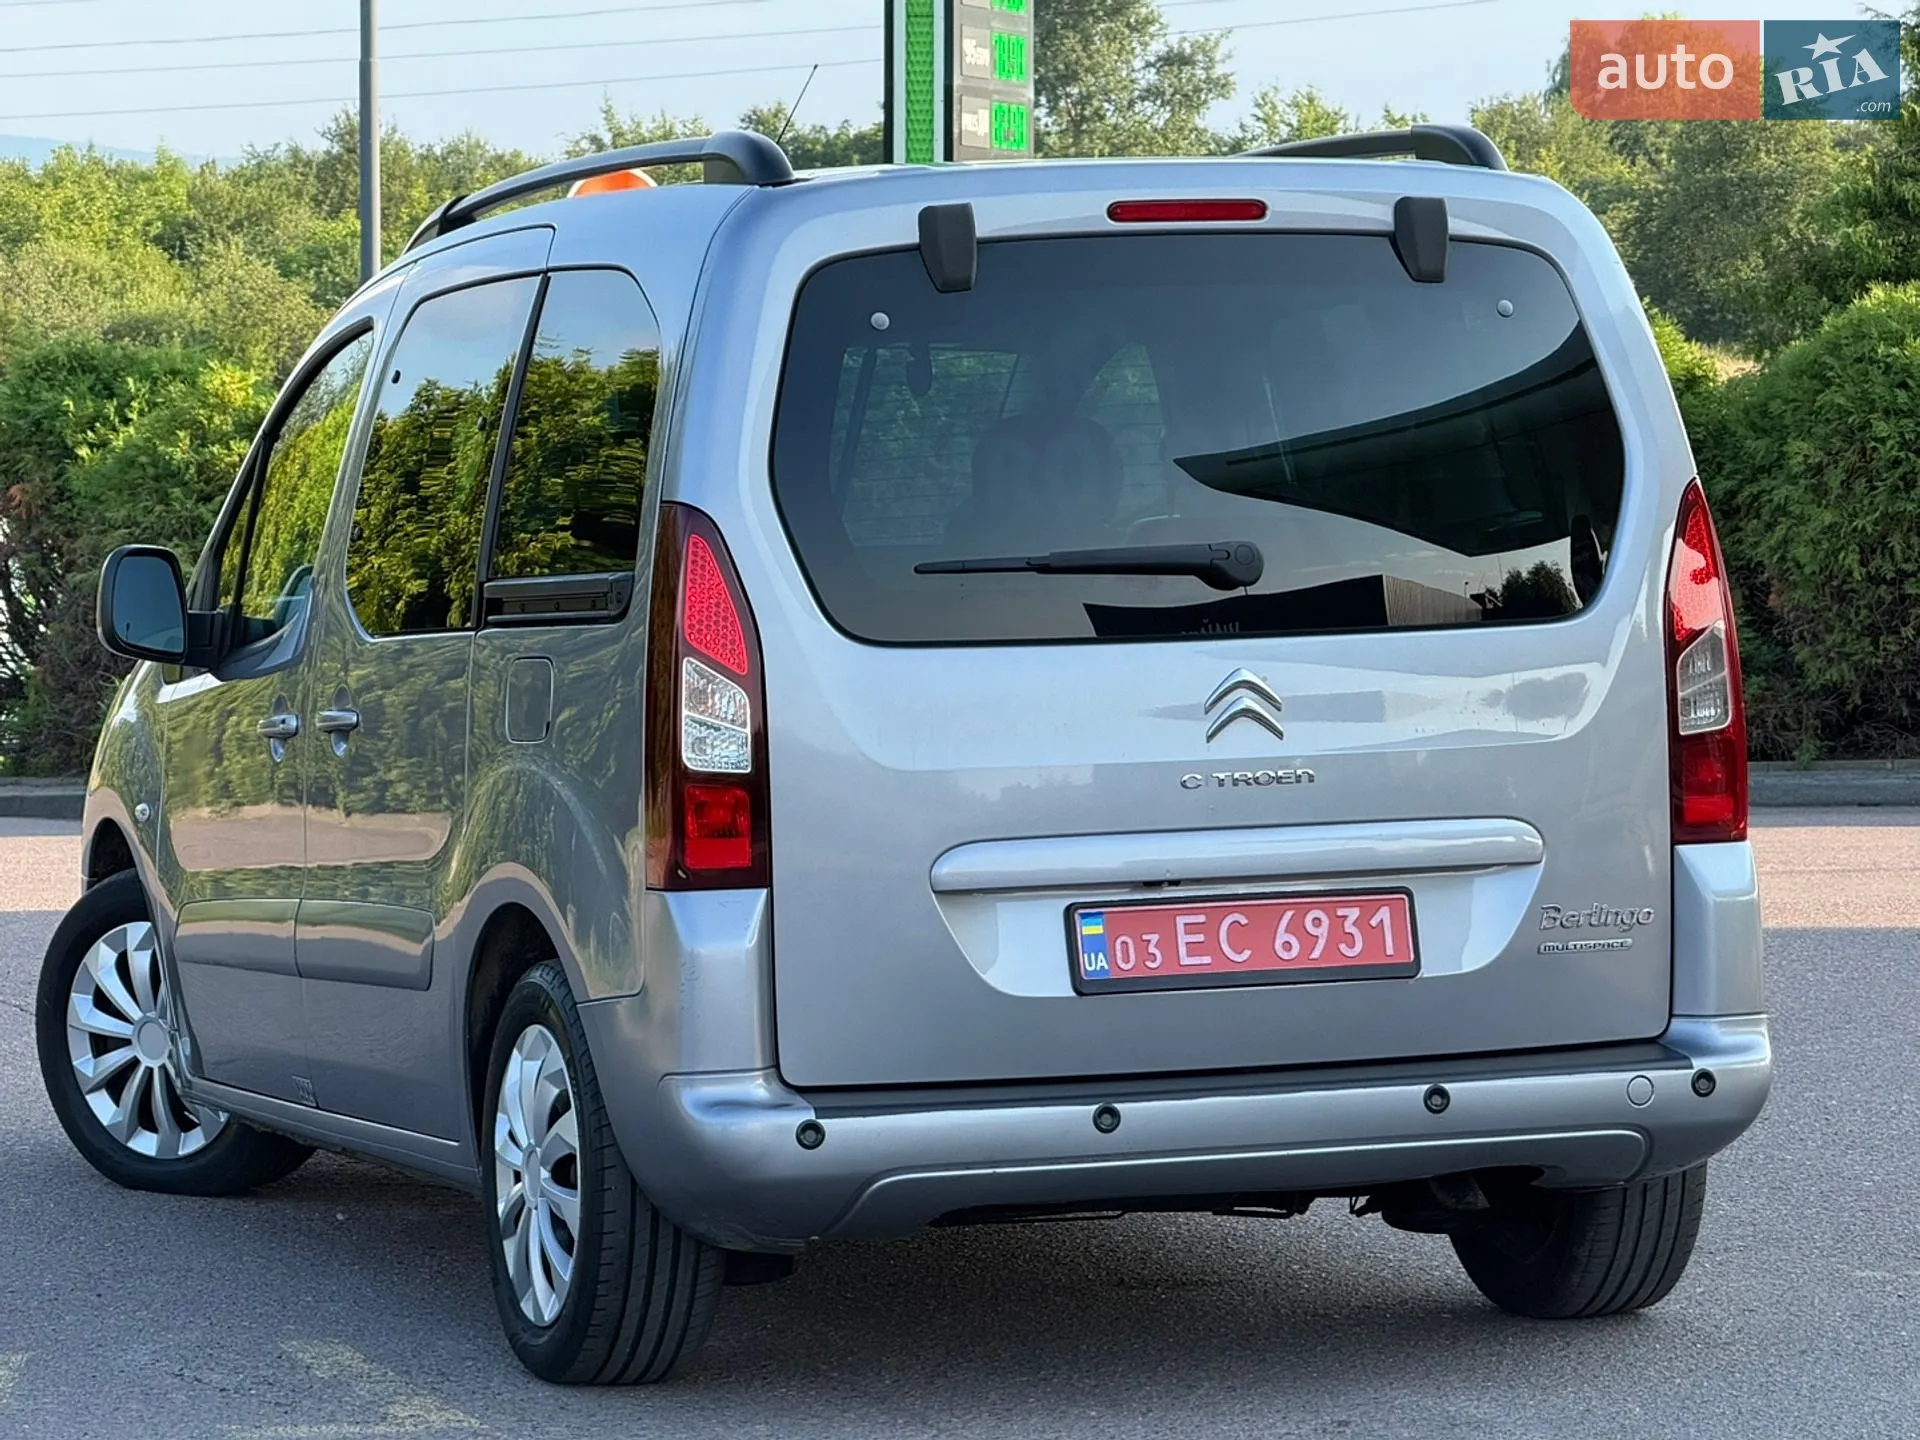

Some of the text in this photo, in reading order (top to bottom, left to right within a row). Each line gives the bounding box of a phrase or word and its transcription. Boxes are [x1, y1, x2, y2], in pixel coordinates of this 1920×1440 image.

[1179, 768, 1316, 790] CTROEN
[1538, 902, 1656, 933] Berlingo
[1113, 905, 1396, 972] 03 EC 6931
[1541, 938, 1631, 953] MULTISPACE
[1083, 951, 1110, 972] UA
